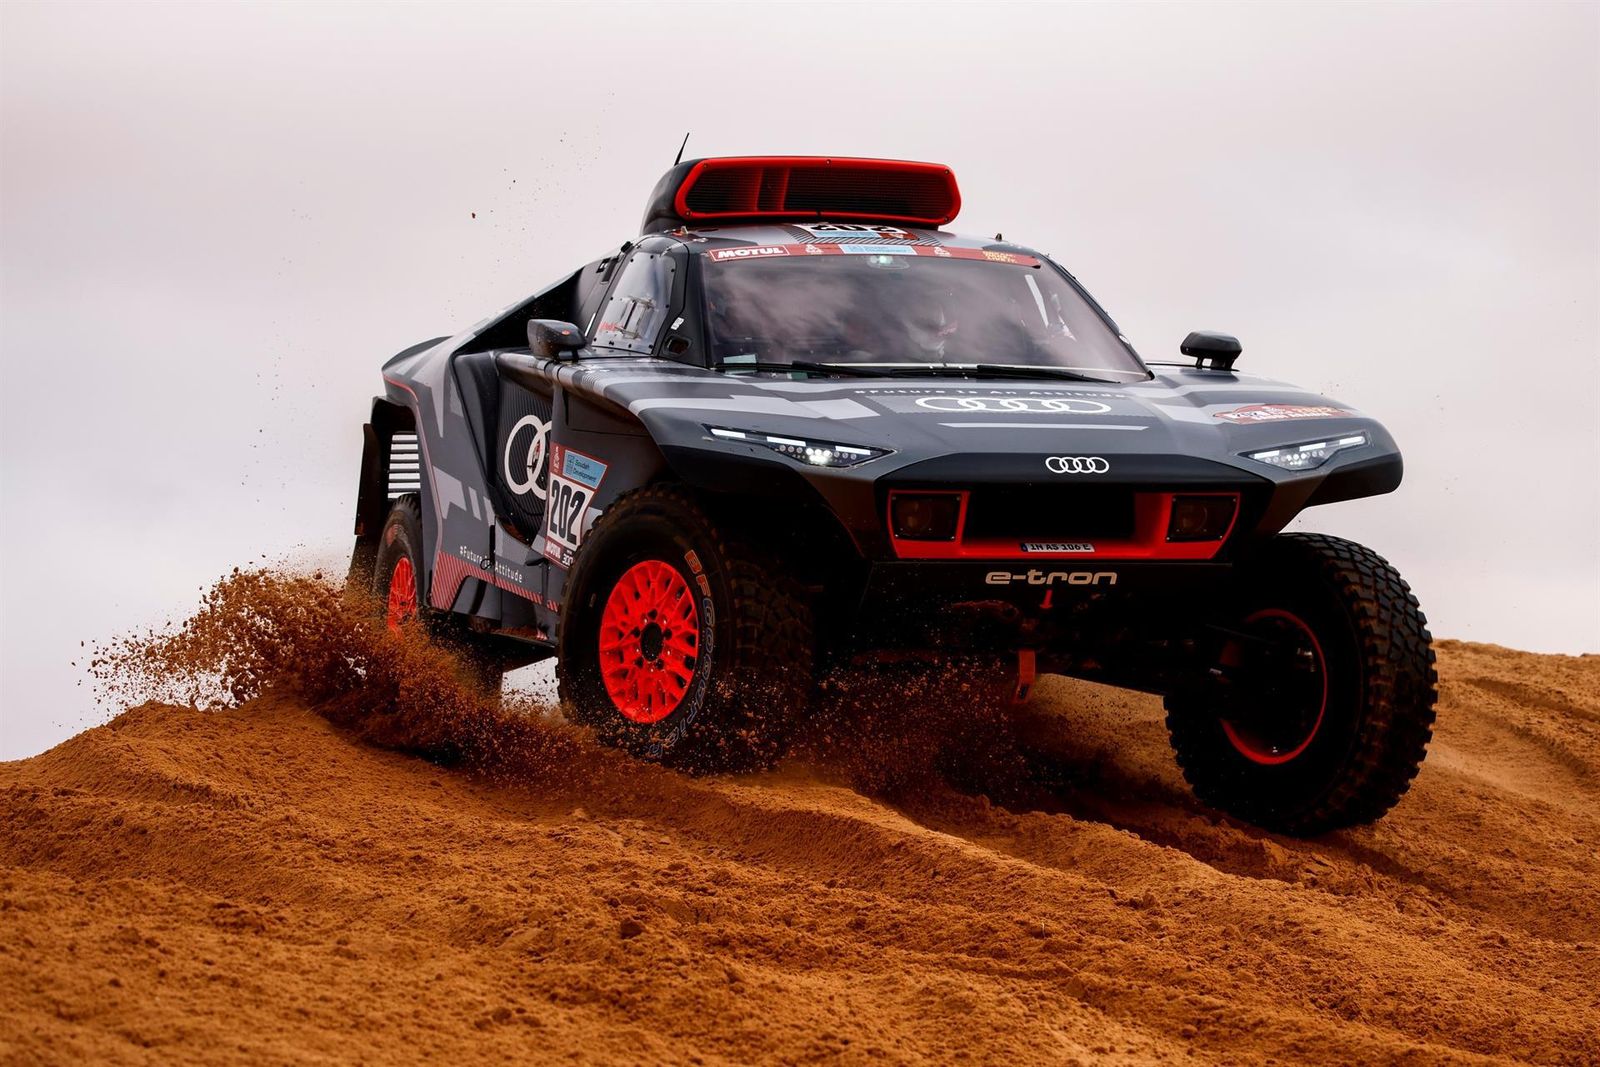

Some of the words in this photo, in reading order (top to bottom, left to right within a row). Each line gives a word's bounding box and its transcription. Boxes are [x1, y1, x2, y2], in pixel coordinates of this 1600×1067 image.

[717, 247, 784, 259] MOTUL
[550, 480, 585, 545] 202
[1046, 543, 1059, 551] AS
[495, 561, 522, 583] Attitude
[985, 569, 1118, 585] e-tron
